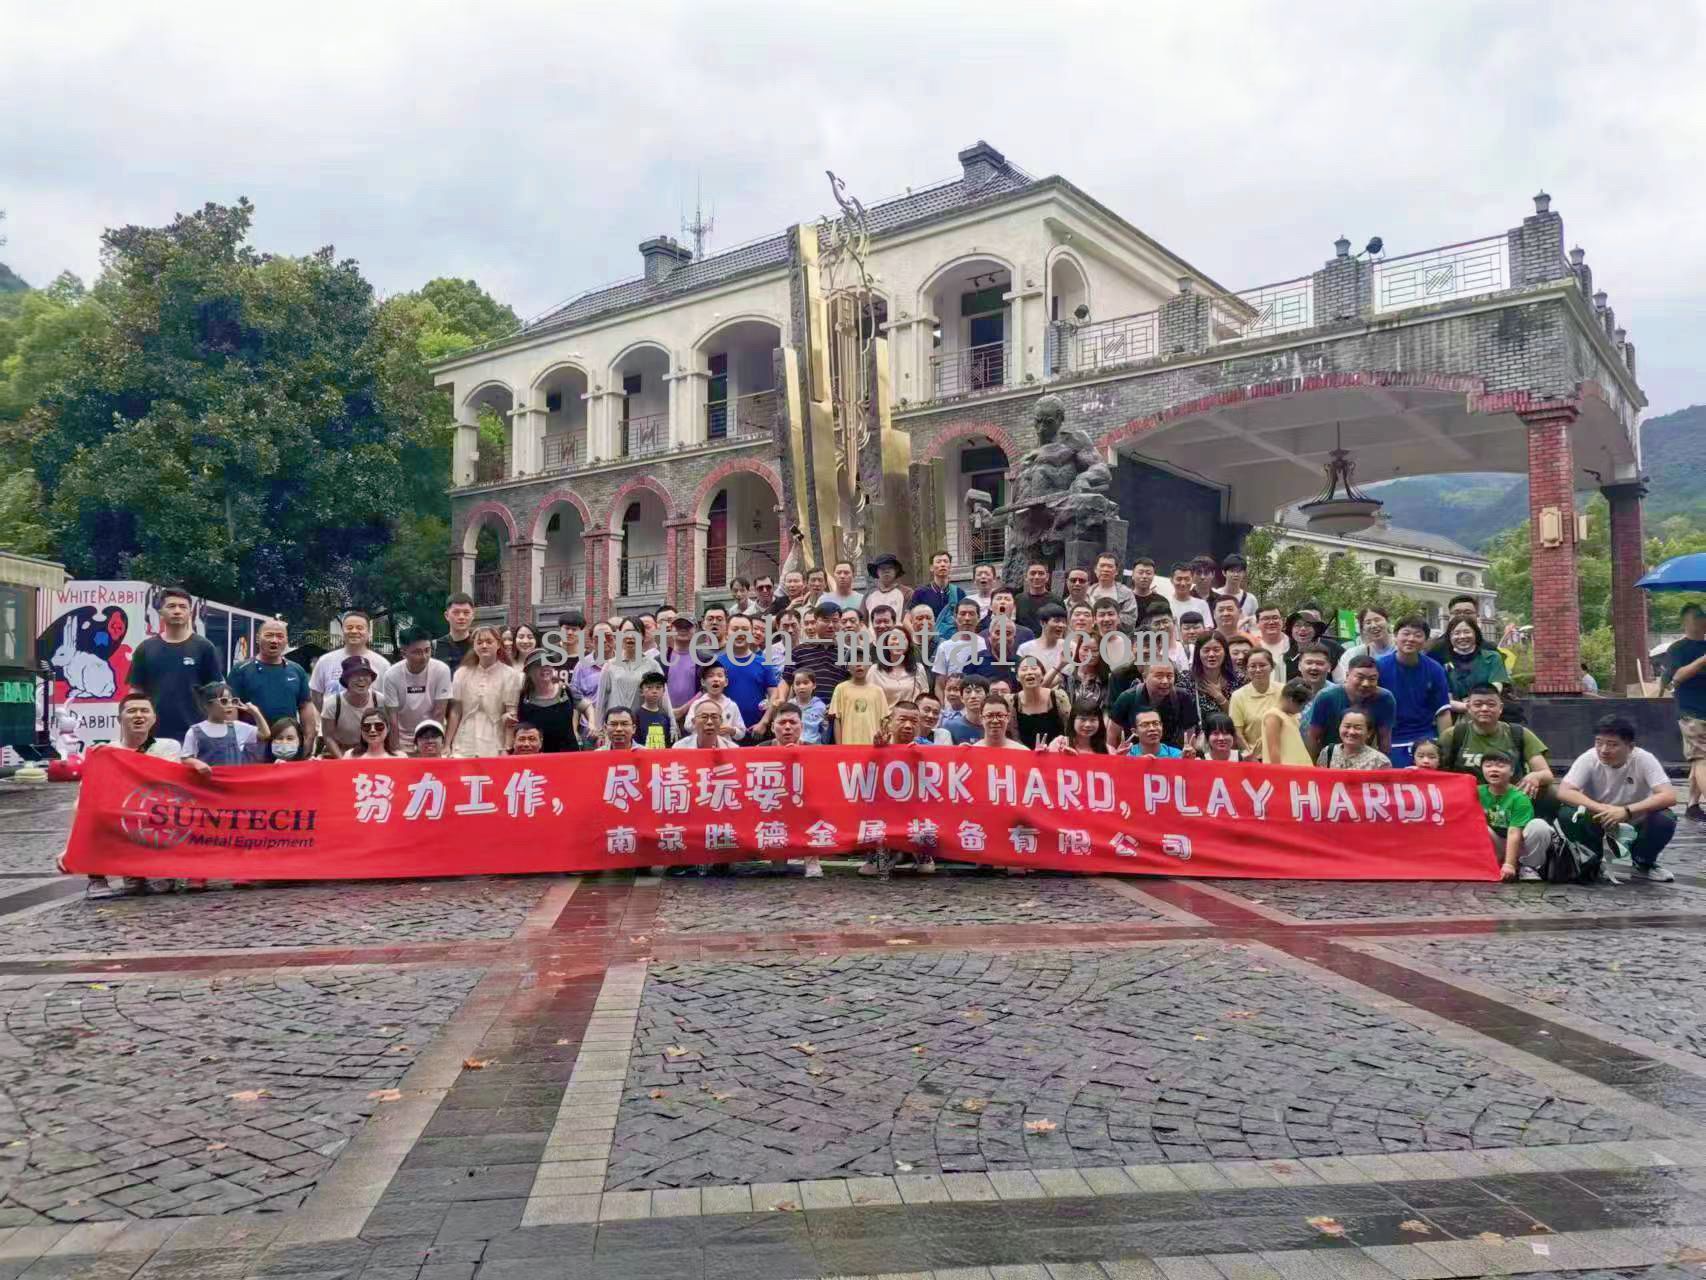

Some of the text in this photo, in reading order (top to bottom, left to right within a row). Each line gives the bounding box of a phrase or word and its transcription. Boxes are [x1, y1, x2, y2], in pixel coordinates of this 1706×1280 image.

[838, 761, 975, 803] WORK
[987, 764, 1131, 819] HARD,
[1143, 773, 1275, 820] PLAY
[1289, 780, 1445, 826] HARD!
[150, 804, 318, 831] SUNTECH
[189, 834, 314, 850] Metal Equipment
[606, 819, 1192, 860] 南京胜德金属装备有限公司
